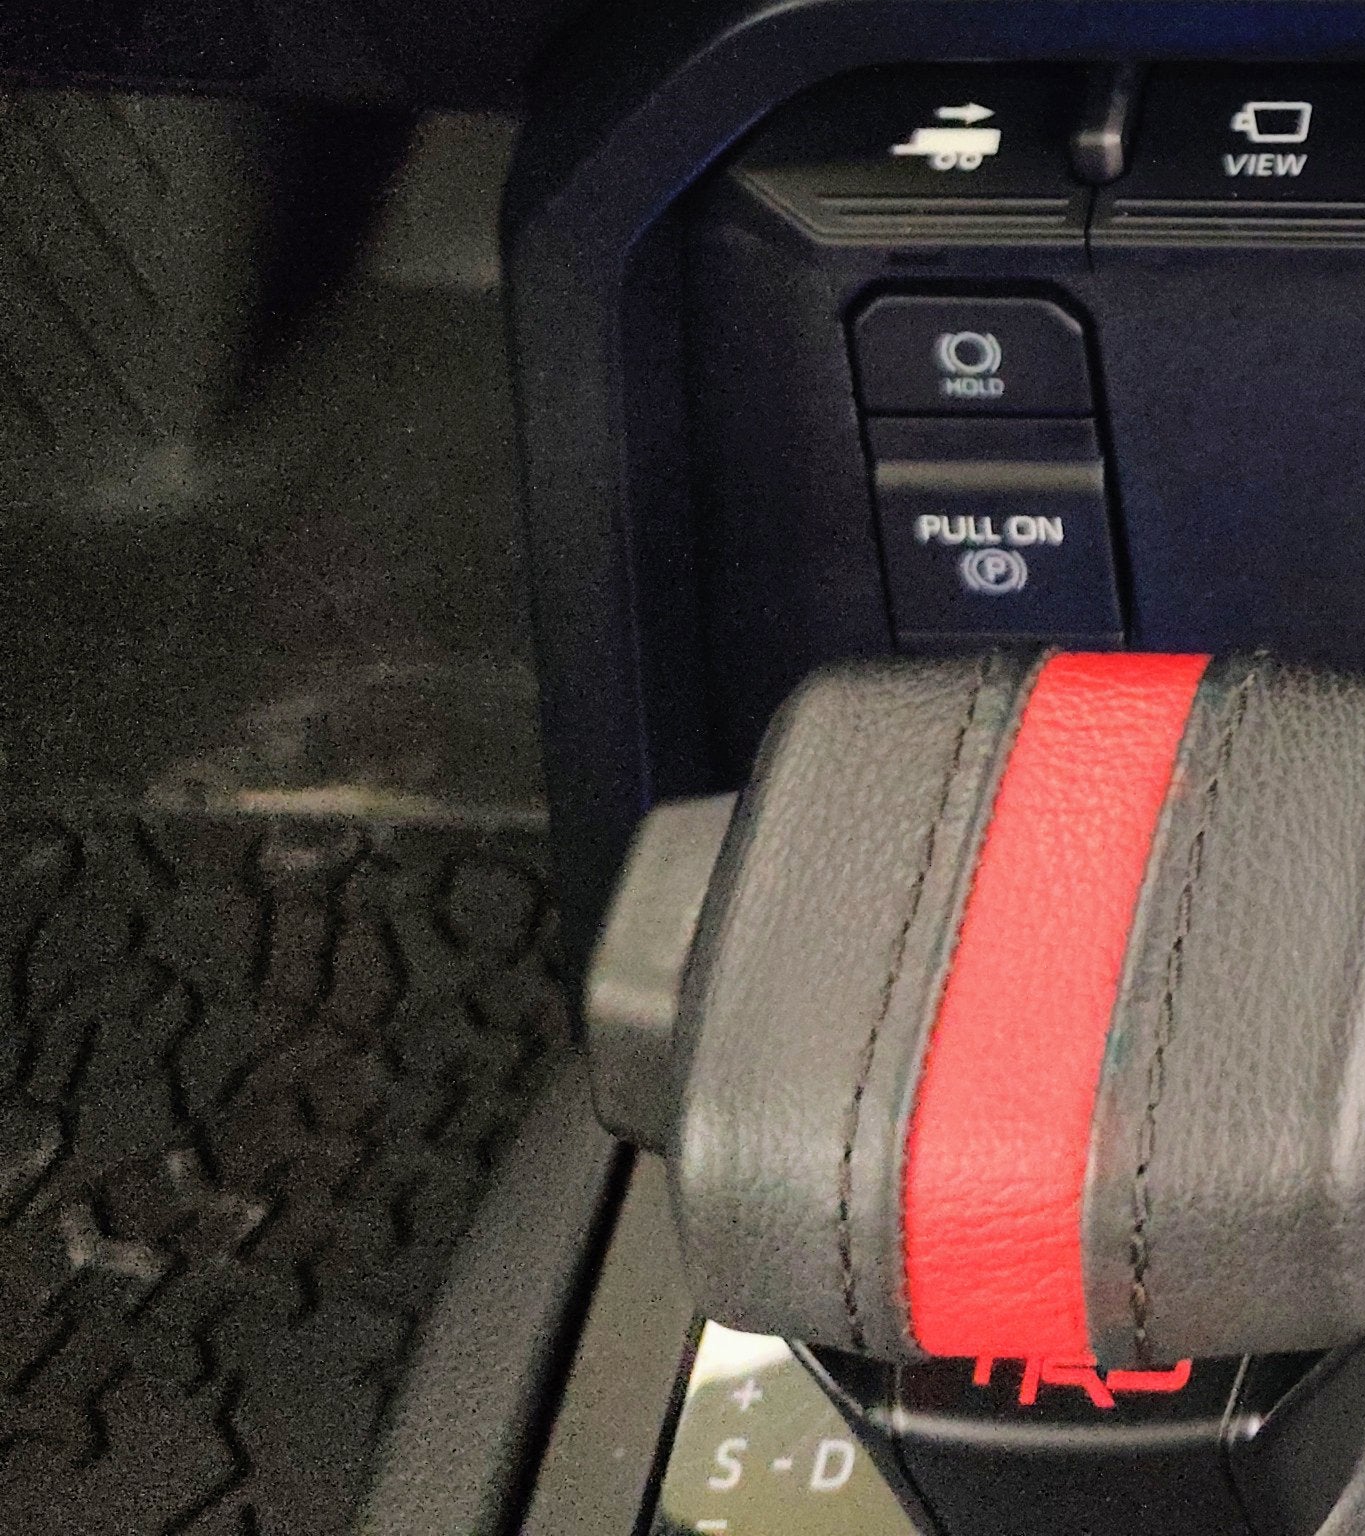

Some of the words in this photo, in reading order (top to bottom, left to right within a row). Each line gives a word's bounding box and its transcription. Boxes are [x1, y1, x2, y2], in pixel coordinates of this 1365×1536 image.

[1223, 152, 1309, 179] VIEW
[942, 376, 1006, 398] HOLD
[916, 512, 1002, 546] PULL
[1006, 513, 1065, 547] ON
